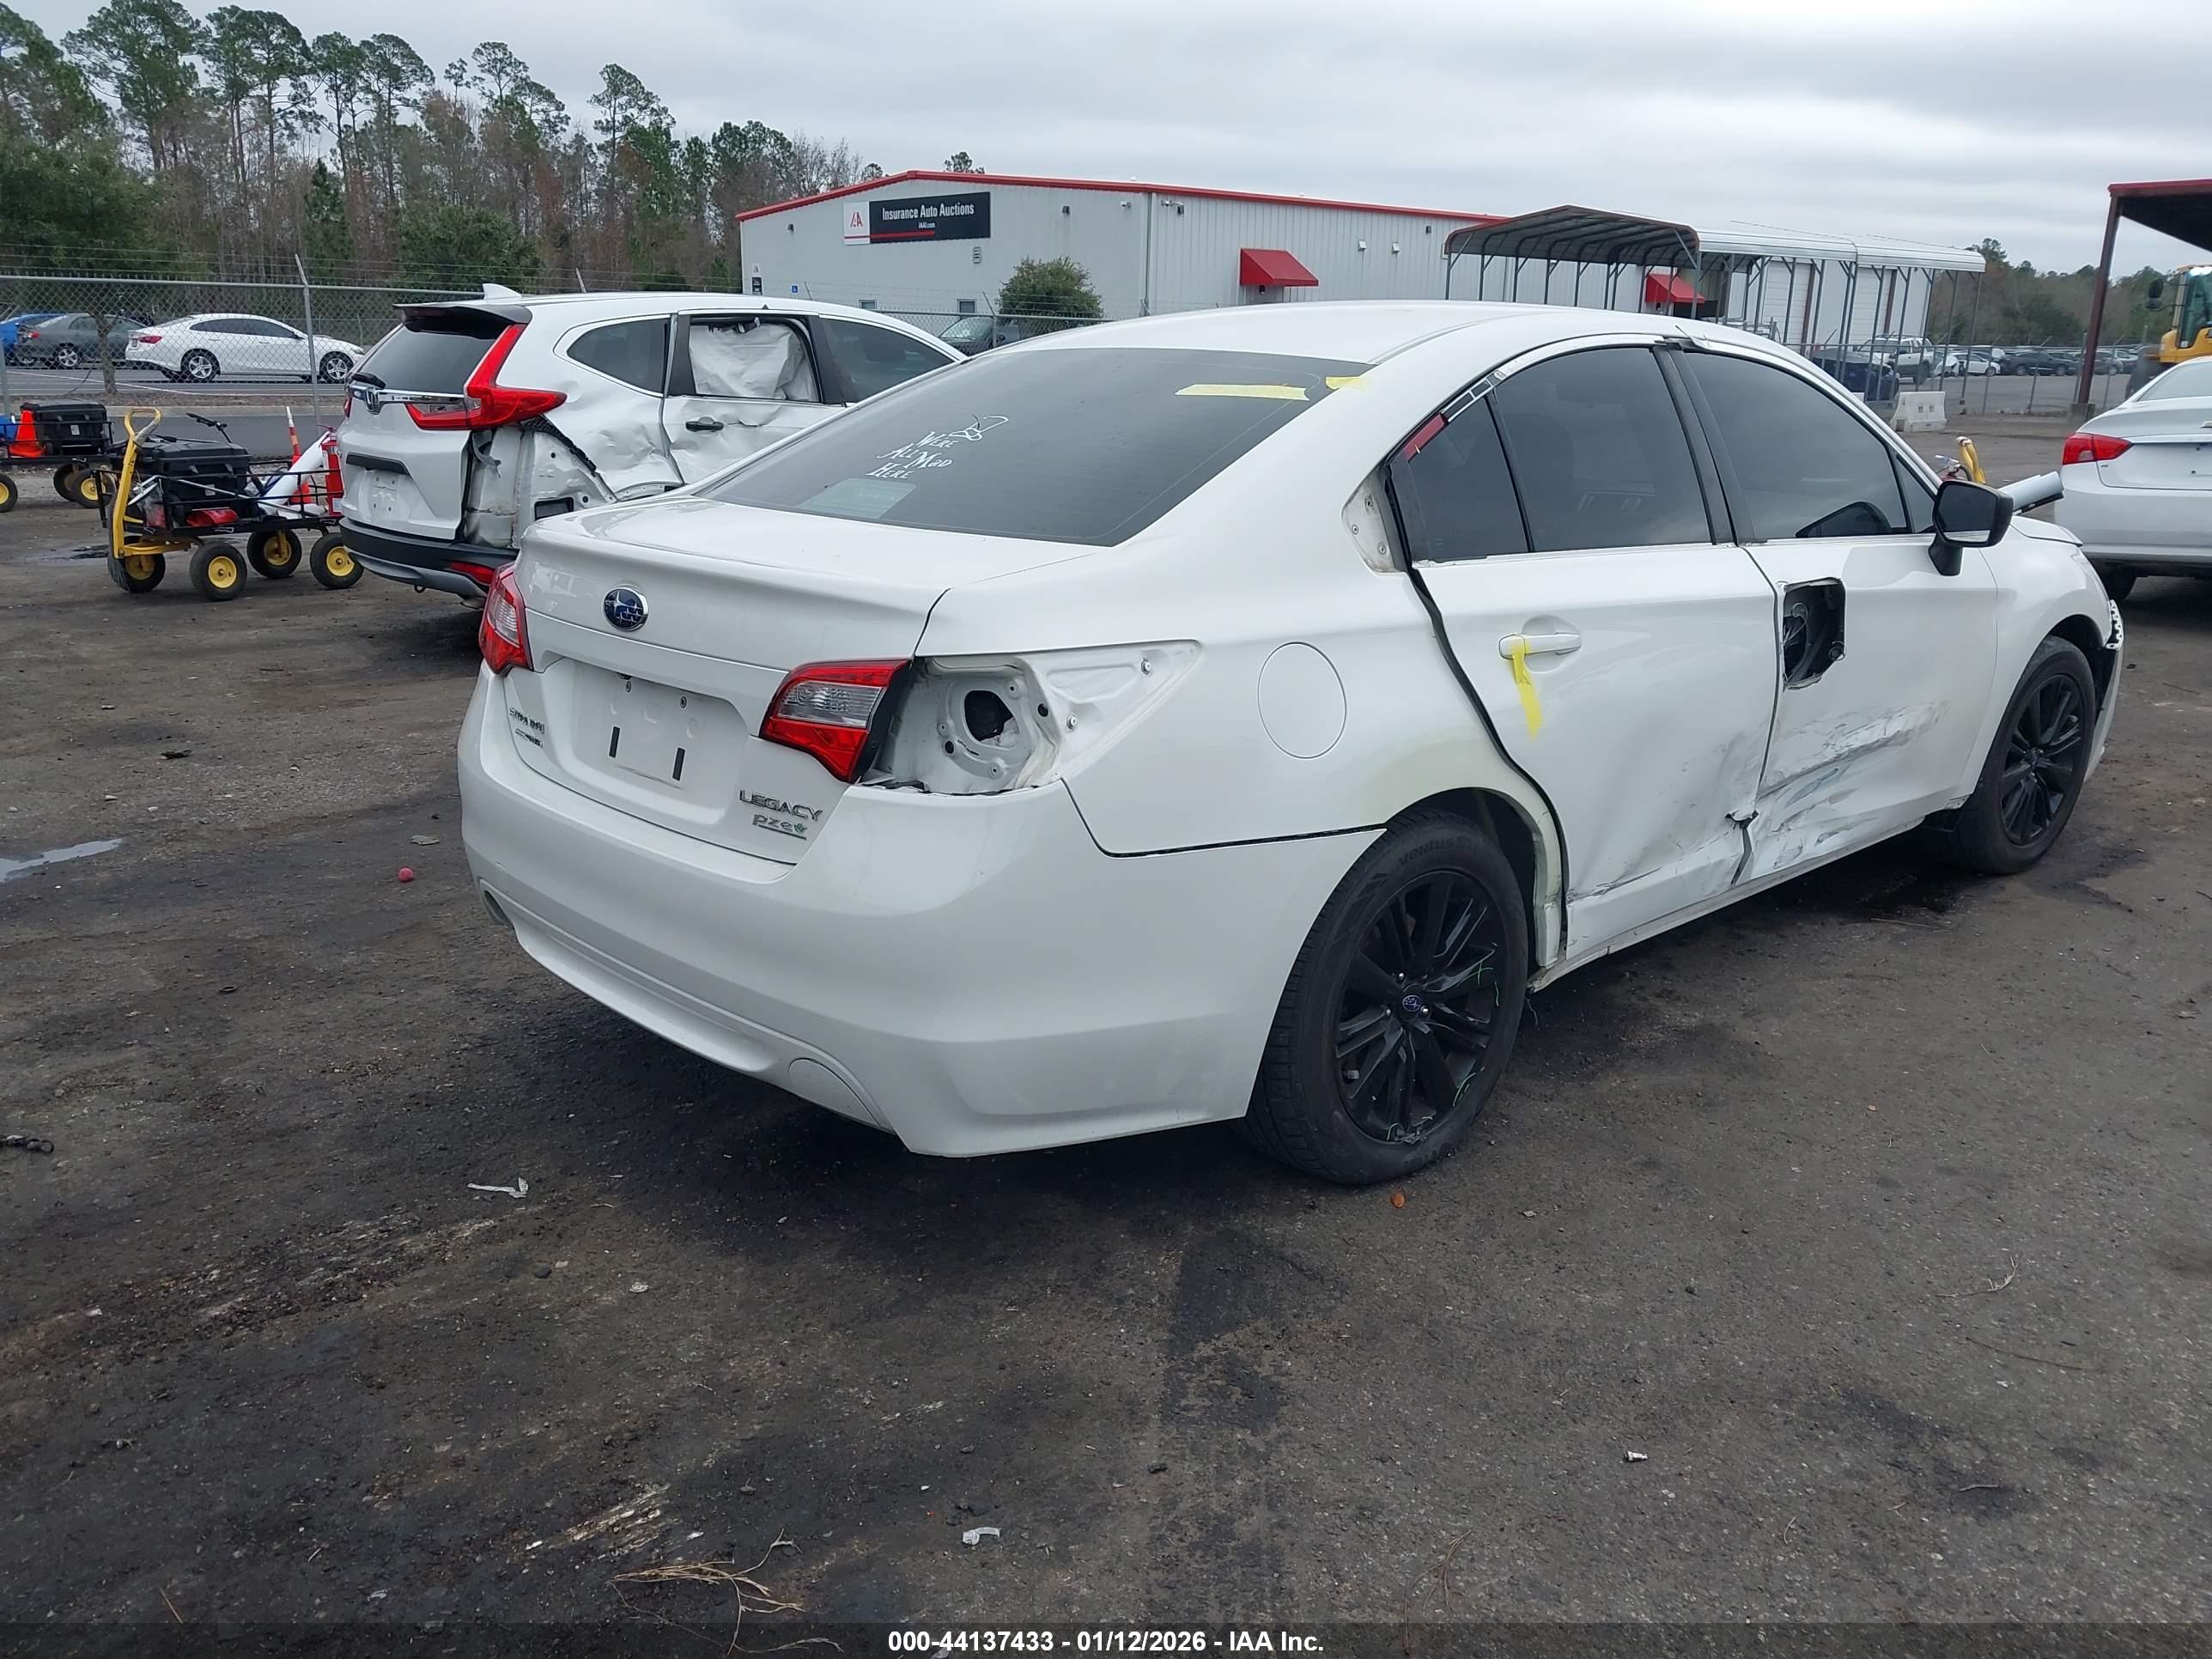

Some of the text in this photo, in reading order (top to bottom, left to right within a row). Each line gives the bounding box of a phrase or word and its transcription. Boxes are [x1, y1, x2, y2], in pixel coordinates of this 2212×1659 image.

[882, 202, 975, 221] Insurance Auto Auctions
[739, 789, 823, 822] LEGACY
